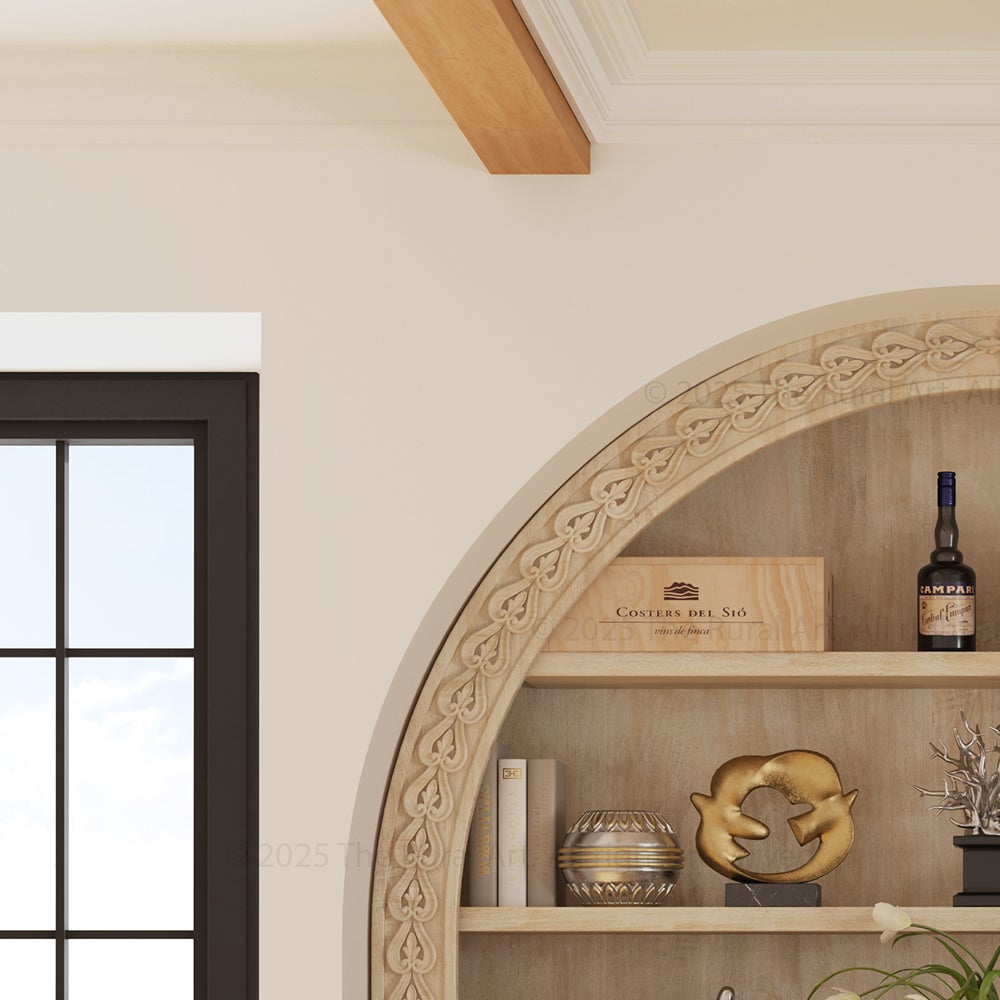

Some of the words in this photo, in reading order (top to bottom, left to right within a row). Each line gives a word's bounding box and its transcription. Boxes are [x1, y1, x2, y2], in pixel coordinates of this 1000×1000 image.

[654, 626, 674, 636] vins
[674, 626, 685, 636] de
[685, 626, 710, 637] finca
